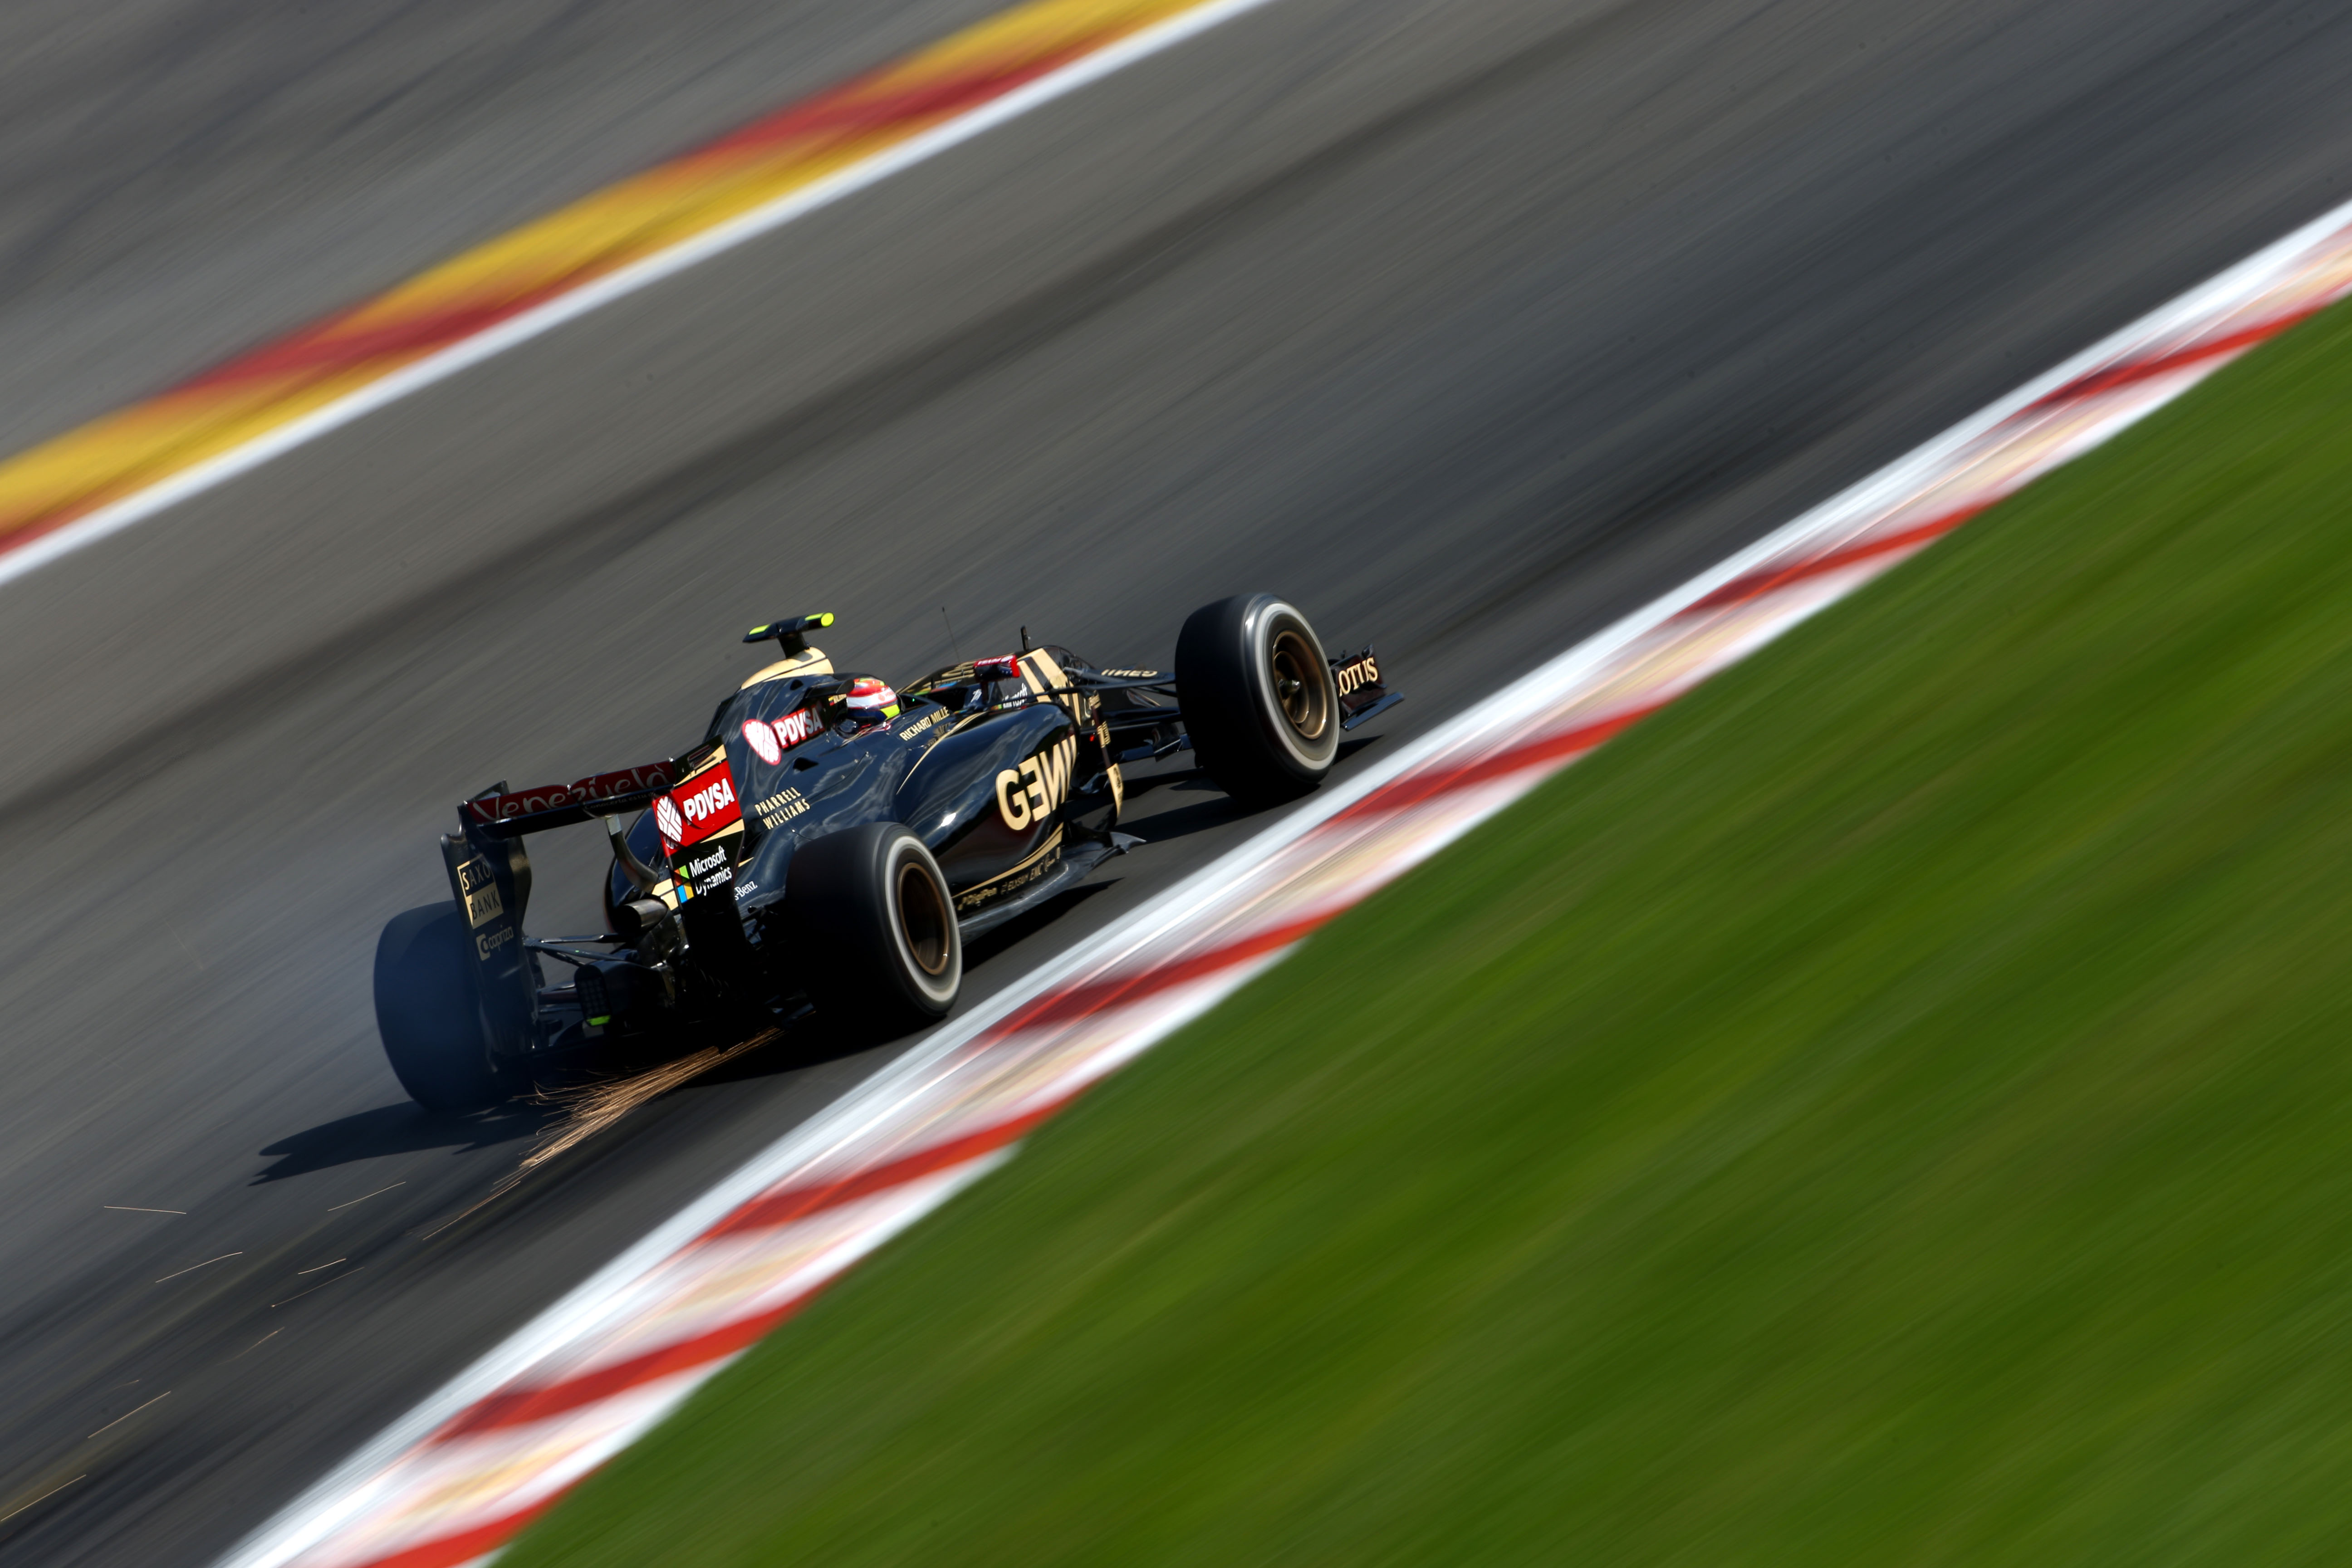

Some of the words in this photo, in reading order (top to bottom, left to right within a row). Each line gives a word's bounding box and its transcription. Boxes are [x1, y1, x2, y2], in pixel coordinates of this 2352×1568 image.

[1338, 657, 1378, 697] OTUS
[774, 707, 823, 747] PDVSA
[899, 716, 932, 741] RICHARD
[931, 706, 950, 725] MILLE
[683, 778, 735, 825] PDVSA
[755, 787, 801, 816] PHARRELL
[763, 799, 810, 829] WILLIAMS
[689, 845, 726, 877] Microsoft
[462, 862, 491, 891] SAXO
[695, 867, 732, 896] Dynamics
[734, 881, 758, 901] s-Benz
[470, 891, 500, 920] BANK
[488, 925, 514, 951] capriza
